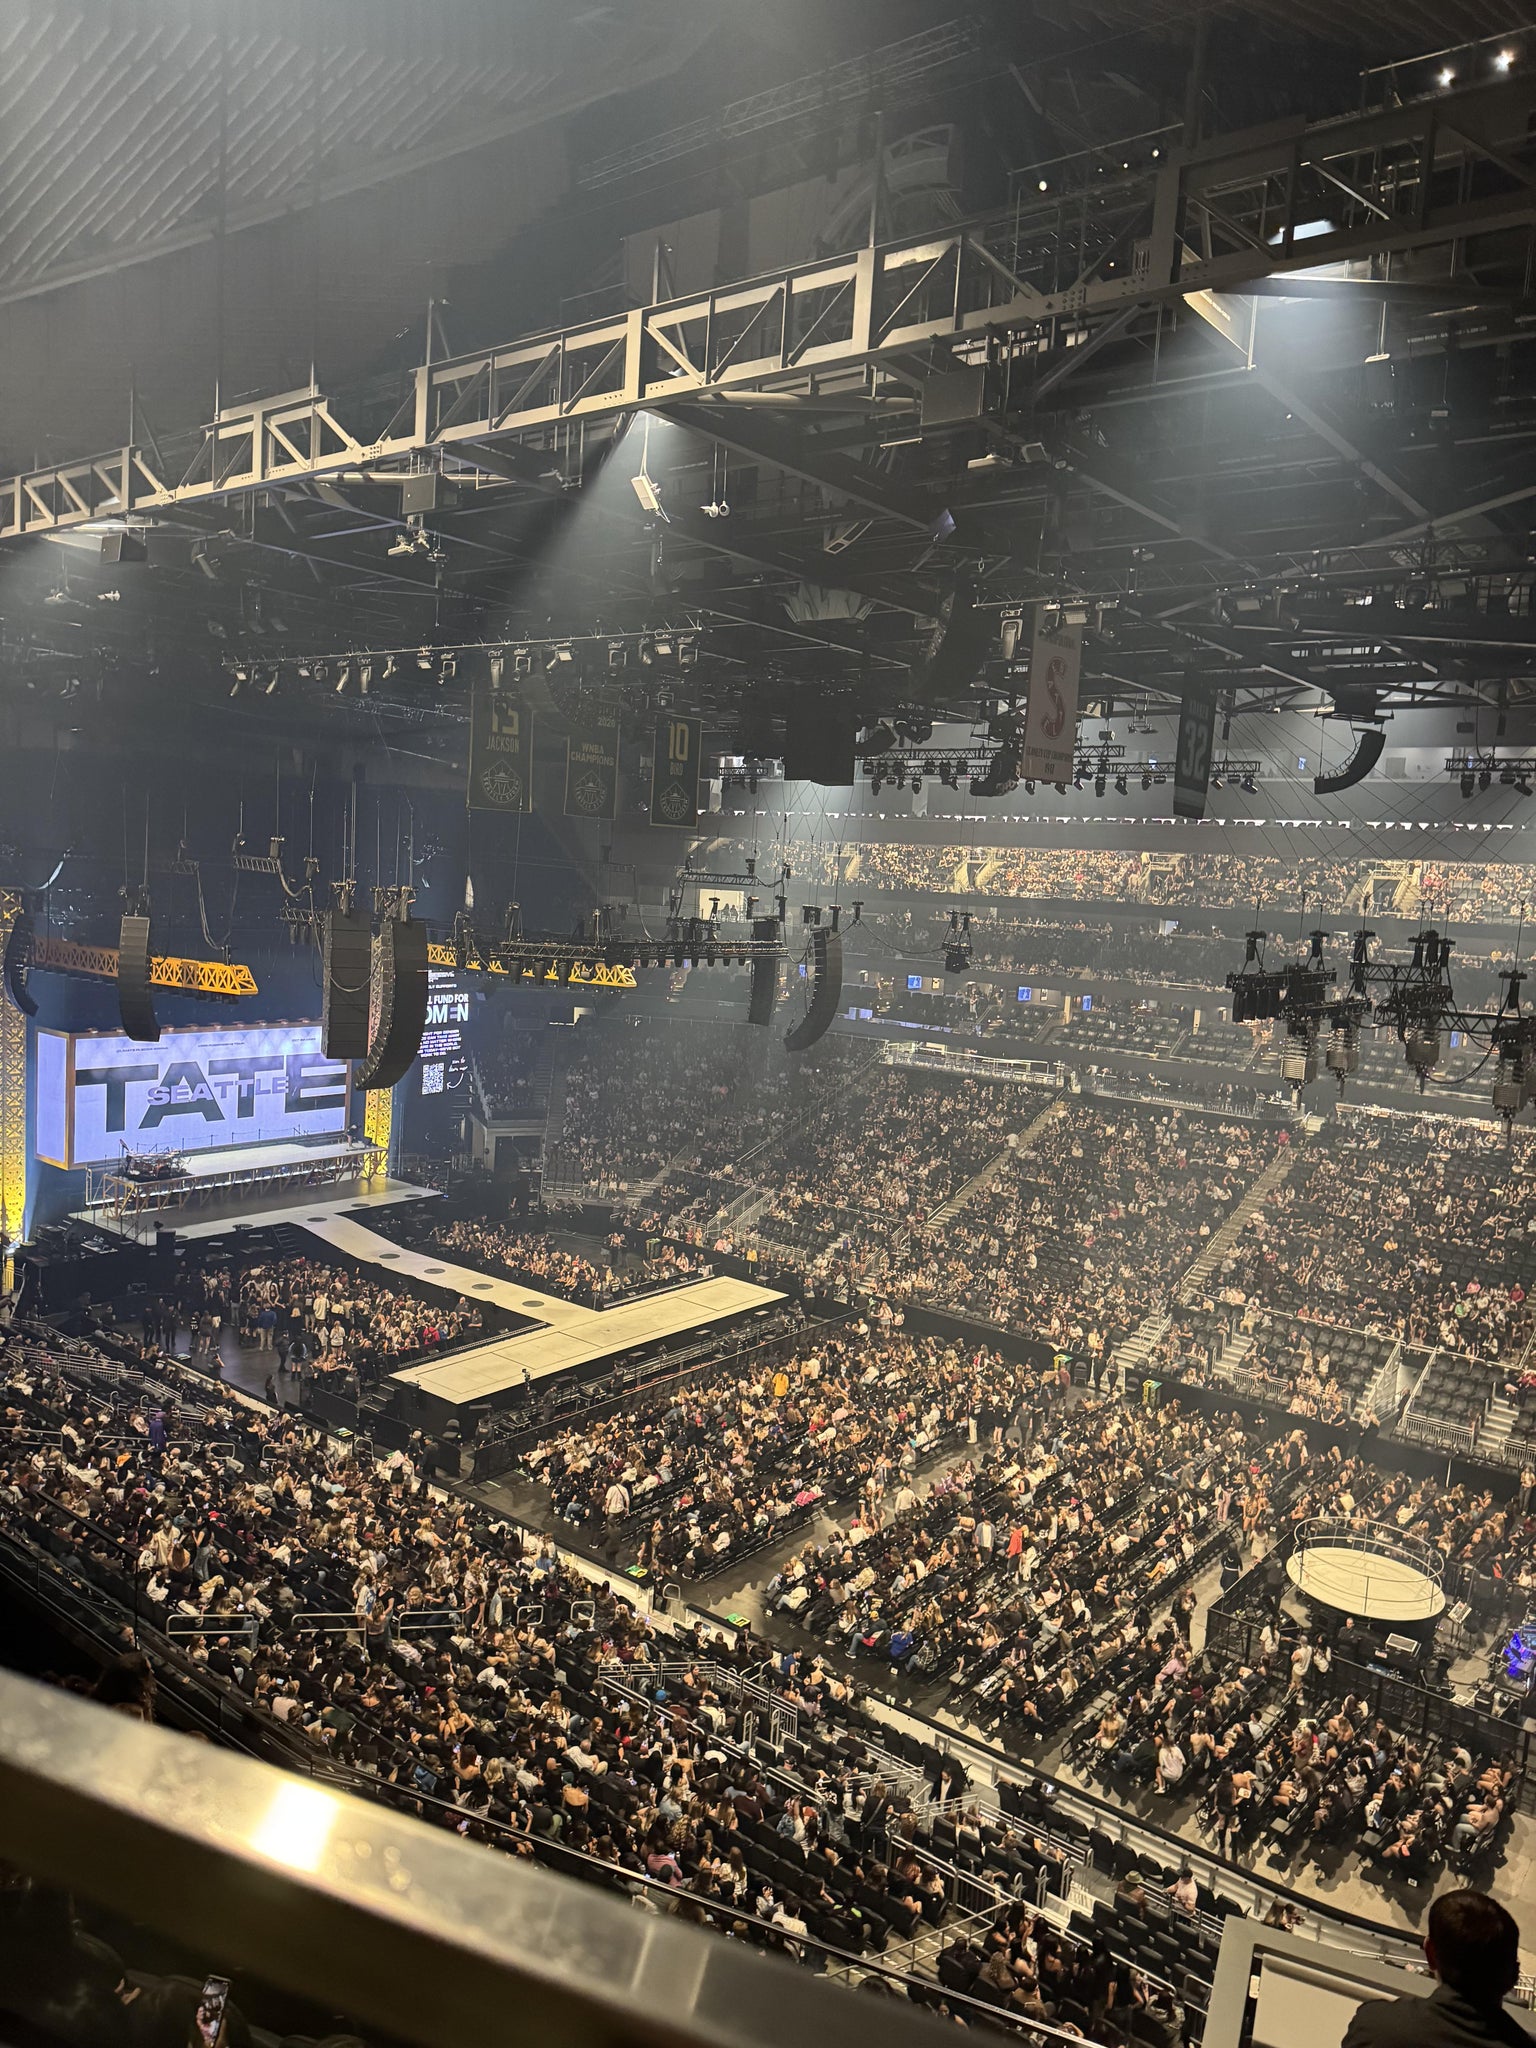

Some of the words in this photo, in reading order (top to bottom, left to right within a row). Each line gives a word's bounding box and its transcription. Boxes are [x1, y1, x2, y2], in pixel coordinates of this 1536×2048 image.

[485, 736, 520, 753] JACKSON
[582, 744, 605, 755] WNBA
[668, 720, 689, 761] 10
[1181, 720, 1209, 781] 32
[570, 751, 615, 767] CHAMPIONS
[433, 994, 454, 1005] FUND
[454, 993, 469, 1004] FOR
[75, 1053, 347, 1133] TATE
[147, 1076, 289, 1106] SEATTLE
